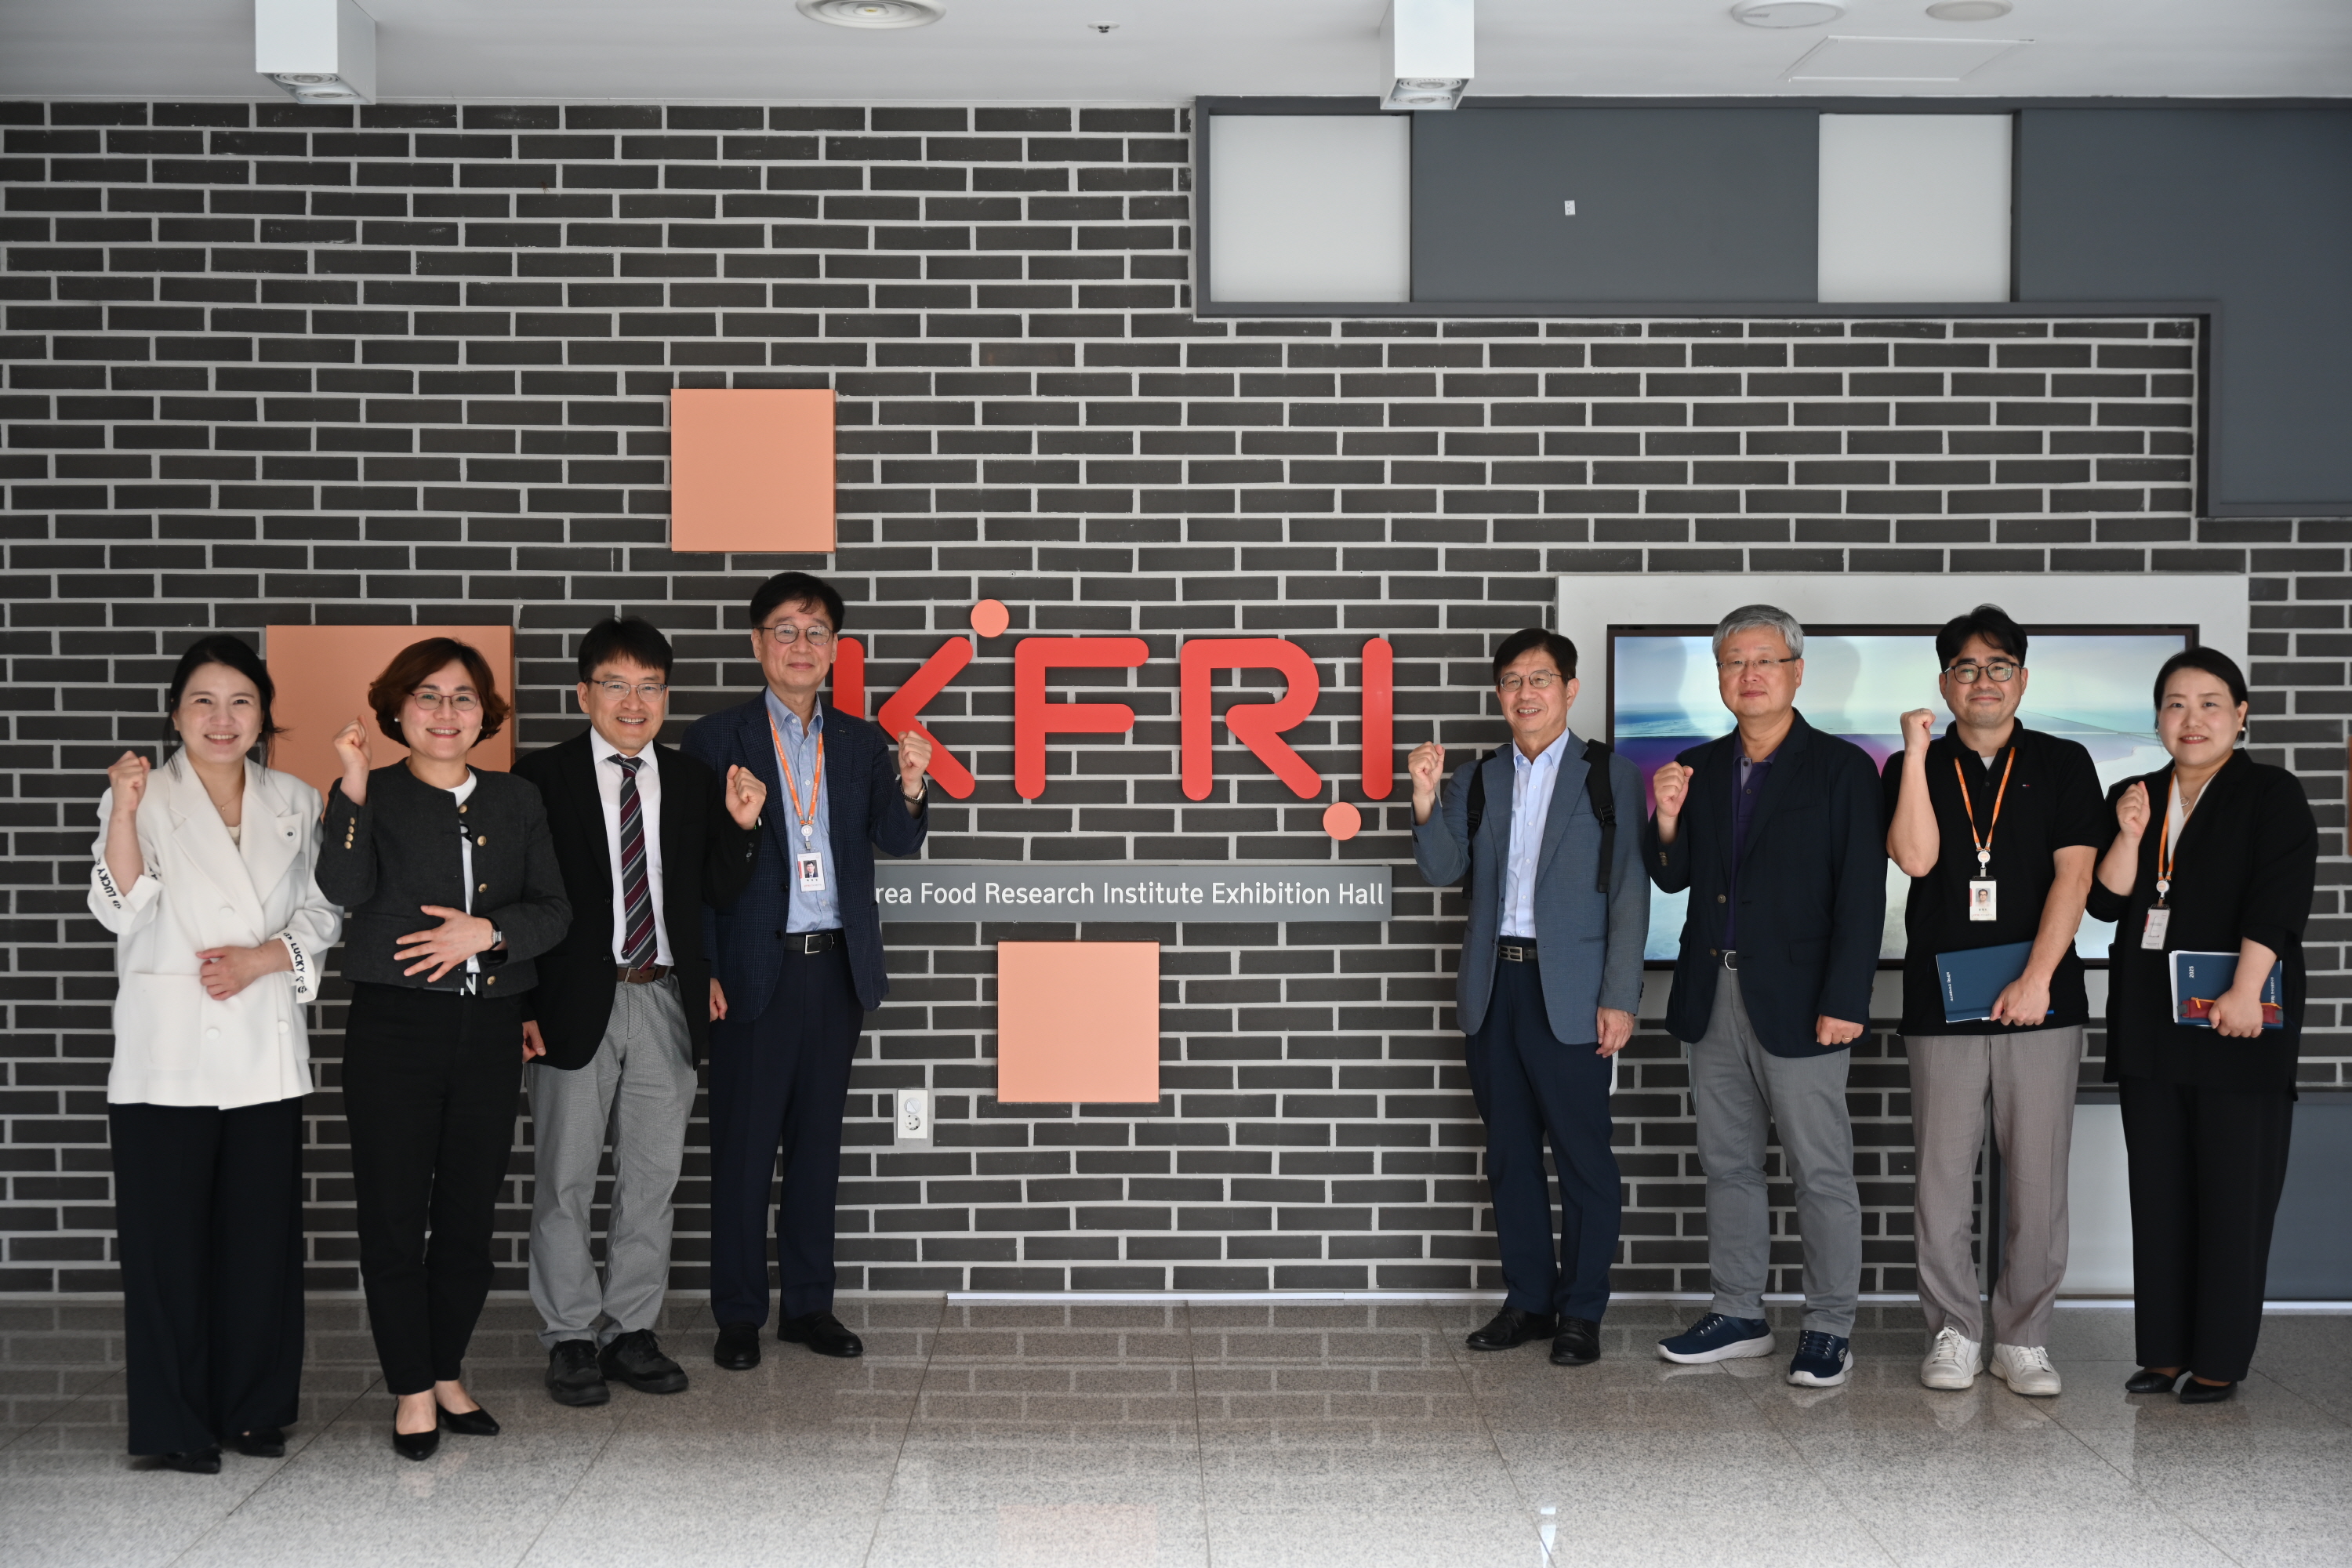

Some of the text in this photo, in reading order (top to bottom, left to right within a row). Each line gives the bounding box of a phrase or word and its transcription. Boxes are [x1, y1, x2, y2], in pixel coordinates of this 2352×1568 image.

[833, 636, 1393, 800] KFRI
[96, 867, 117, 898] LUCKY
[875, 881, 1384, 905] rea Food Research Institute Exhibition Hall
[290, 942, 306, 973] LUCKY
